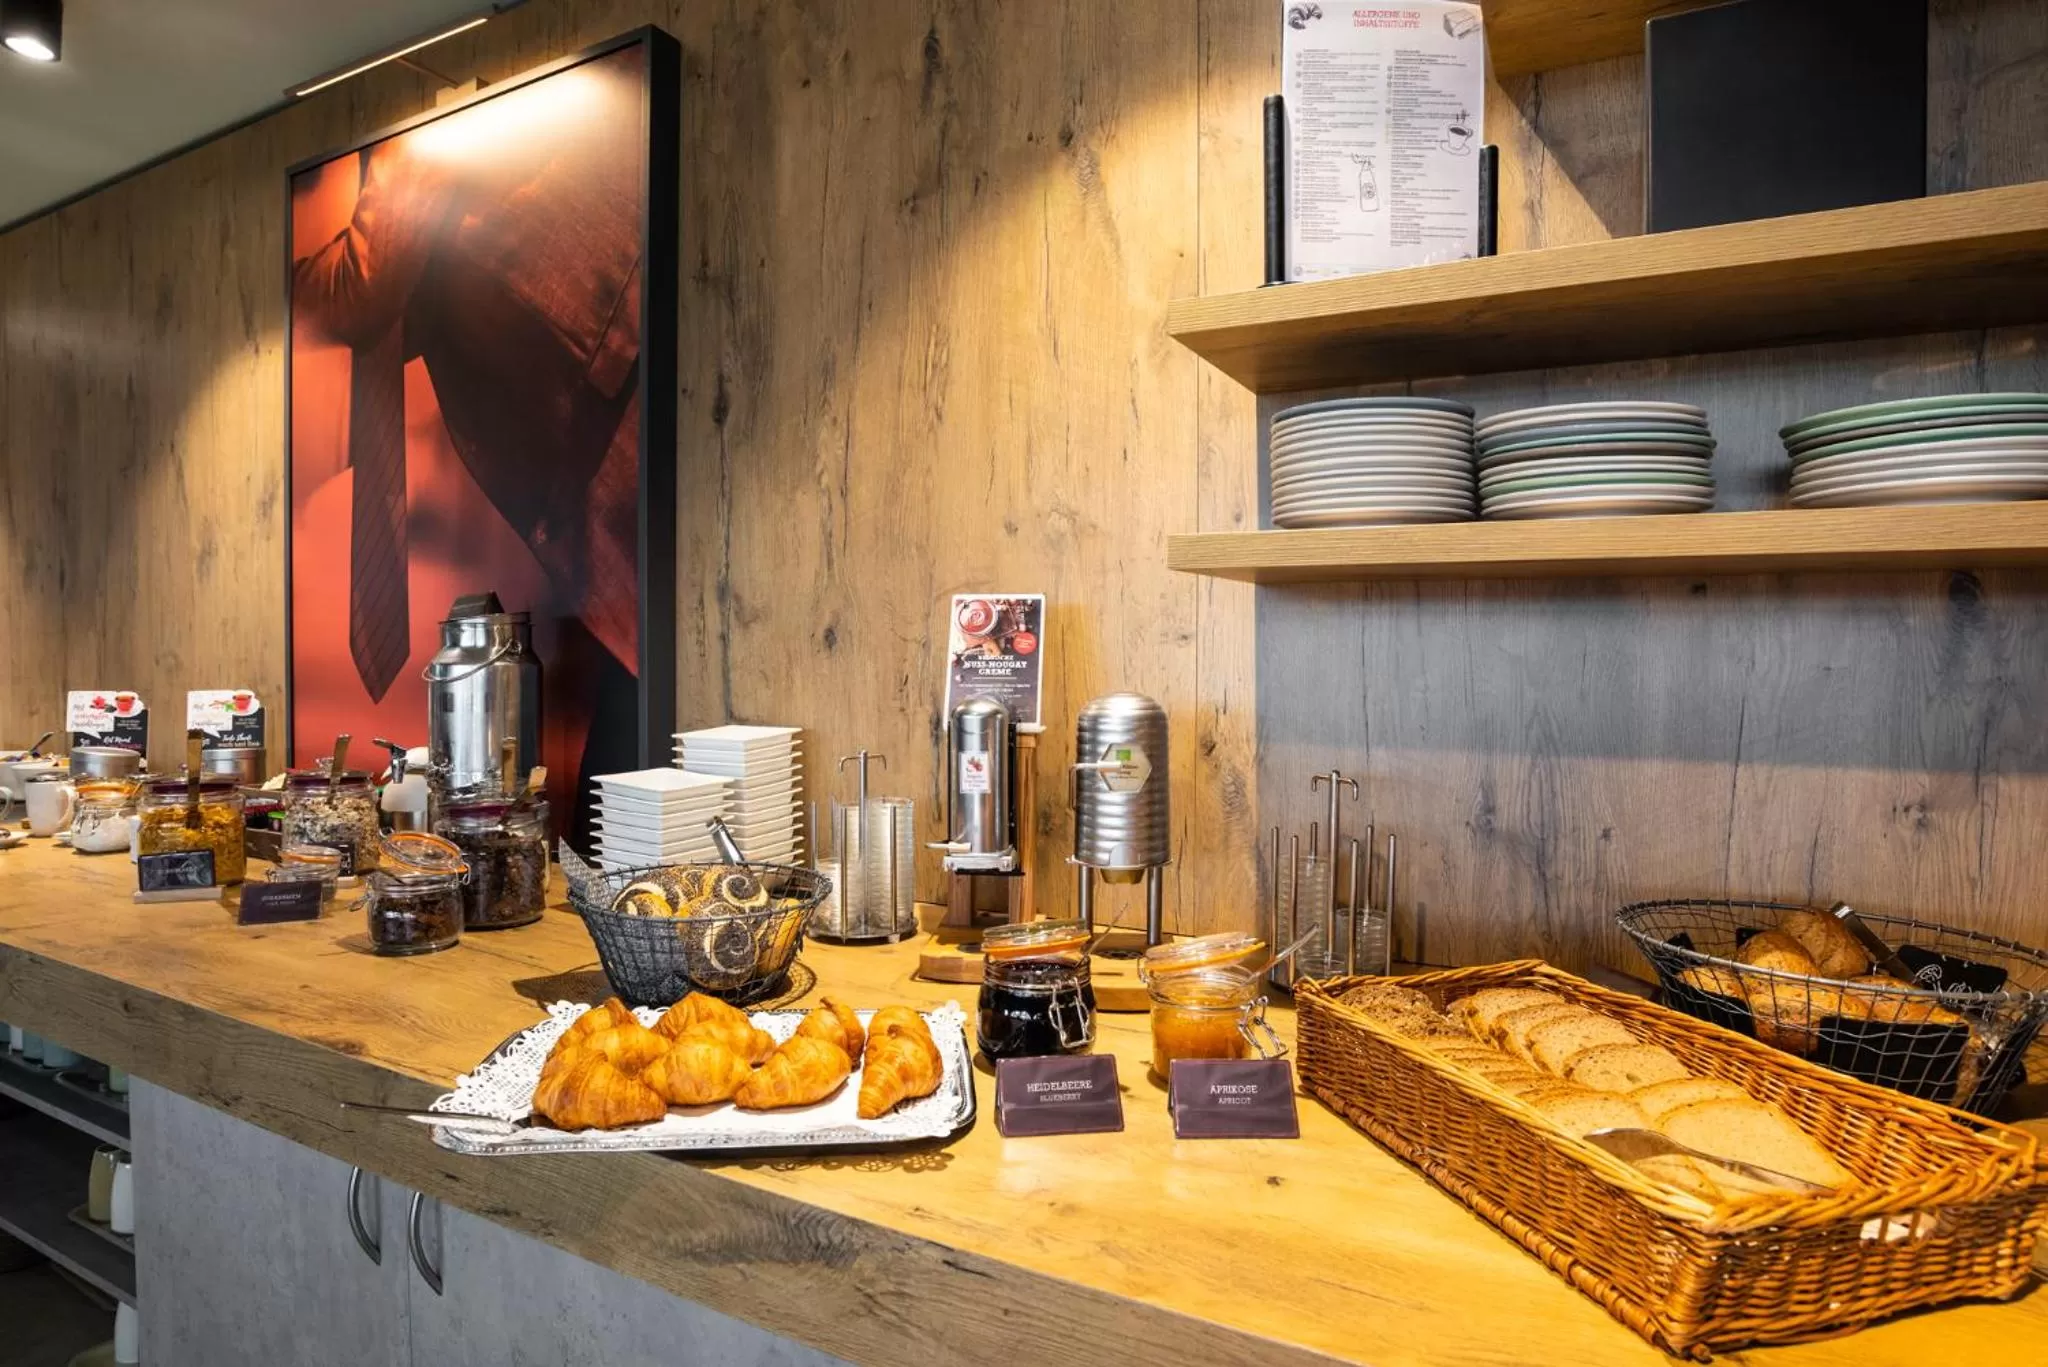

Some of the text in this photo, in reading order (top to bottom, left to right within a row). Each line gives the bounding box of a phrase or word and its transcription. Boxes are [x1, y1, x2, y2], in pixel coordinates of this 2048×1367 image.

[1026, 1079, 1094, 1092] HEIDELBEERE
[1210, 1084, 1259, 1094] APRIKOSE
[1218, 1097, 1252, 1105] APRICOT
